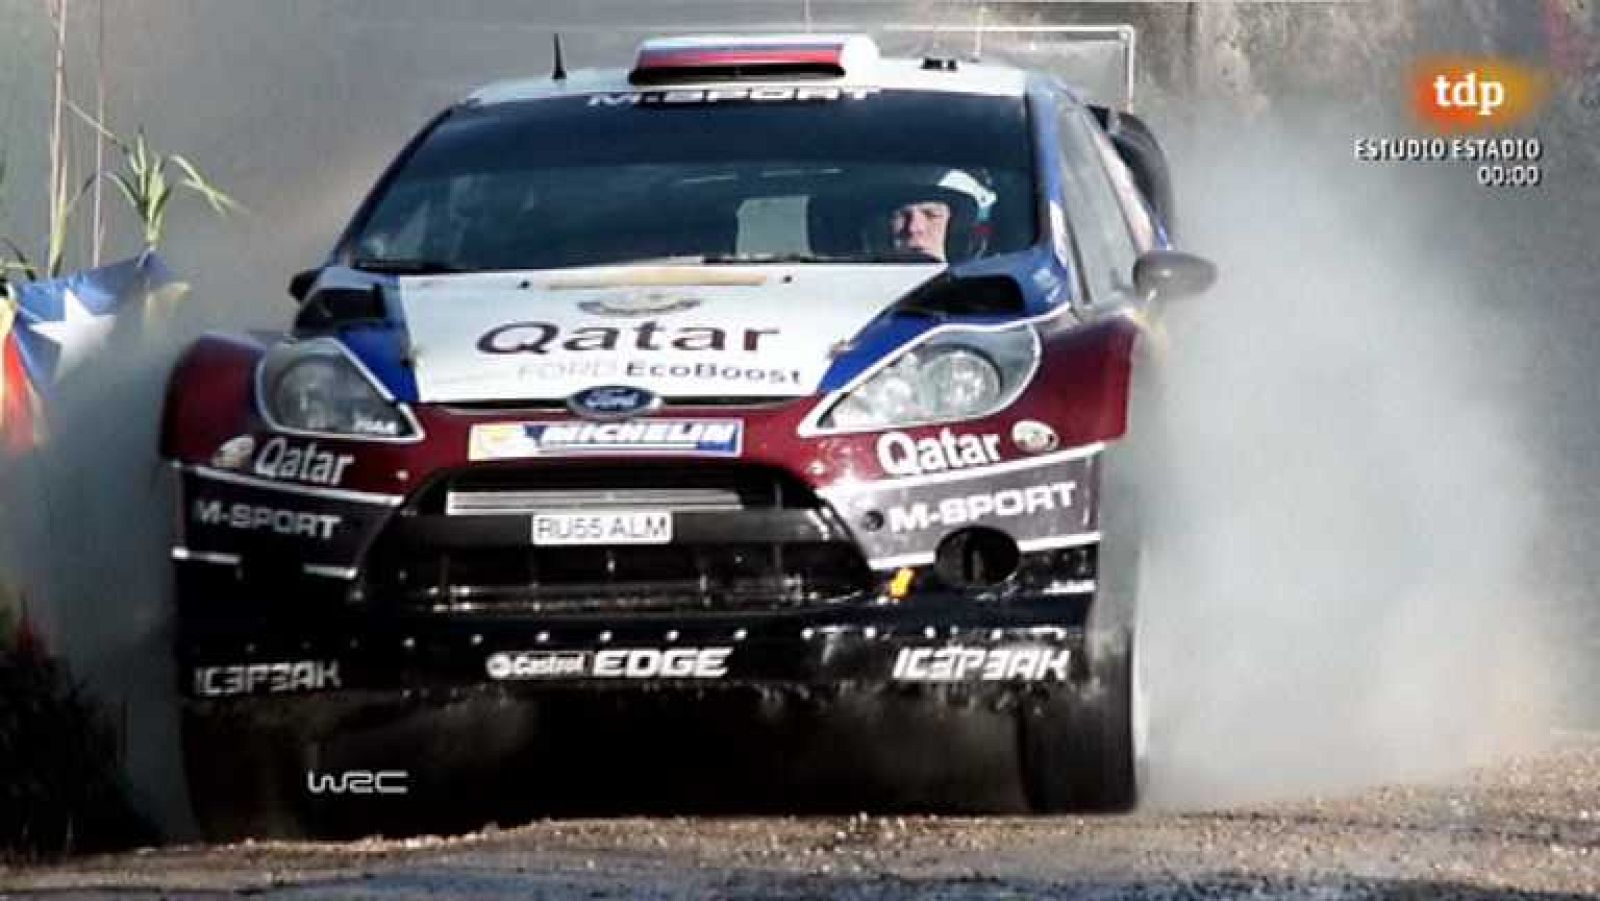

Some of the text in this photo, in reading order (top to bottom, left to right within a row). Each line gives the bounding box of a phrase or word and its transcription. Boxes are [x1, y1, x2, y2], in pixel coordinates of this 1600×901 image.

[476, 319, 780, 356] Qatar
[625, 361, 802, 386] EcoBoost
[537, 420, 738, 446] MICHELIN
[254, 437, 353, 486] Qatar
[877, 428, 1001, 476] Qatar
[193, 499, 342, 540] M-SPORT
[888, 481, 1077, 533] M-SPORT
[608, 514, 668, 540] ALM
[593, 647, 734, 678] EDGE
